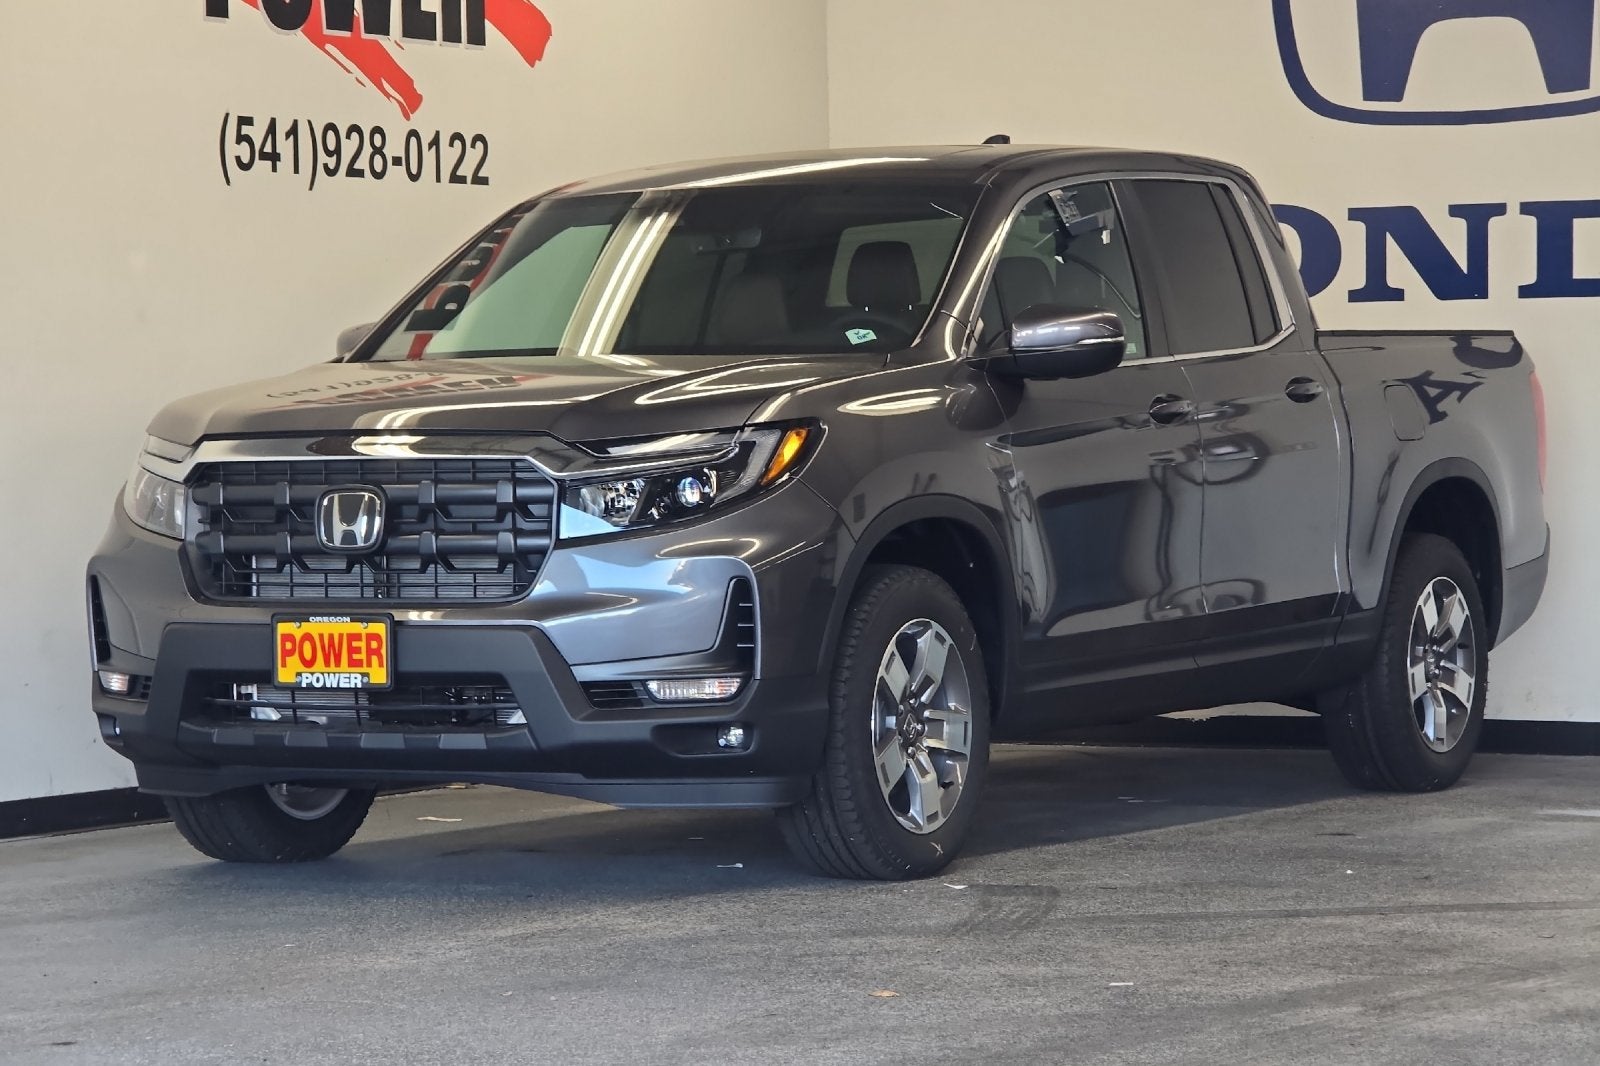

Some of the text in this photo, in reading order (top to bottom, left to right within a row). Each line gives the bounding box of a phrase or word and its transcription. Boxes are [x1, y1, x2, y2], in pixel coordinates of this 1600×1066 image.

[219, 112, 490, 191] (541)928-0122
[280, 632, 384, 668] POWER
[301, 673, 362, 688] POWER
